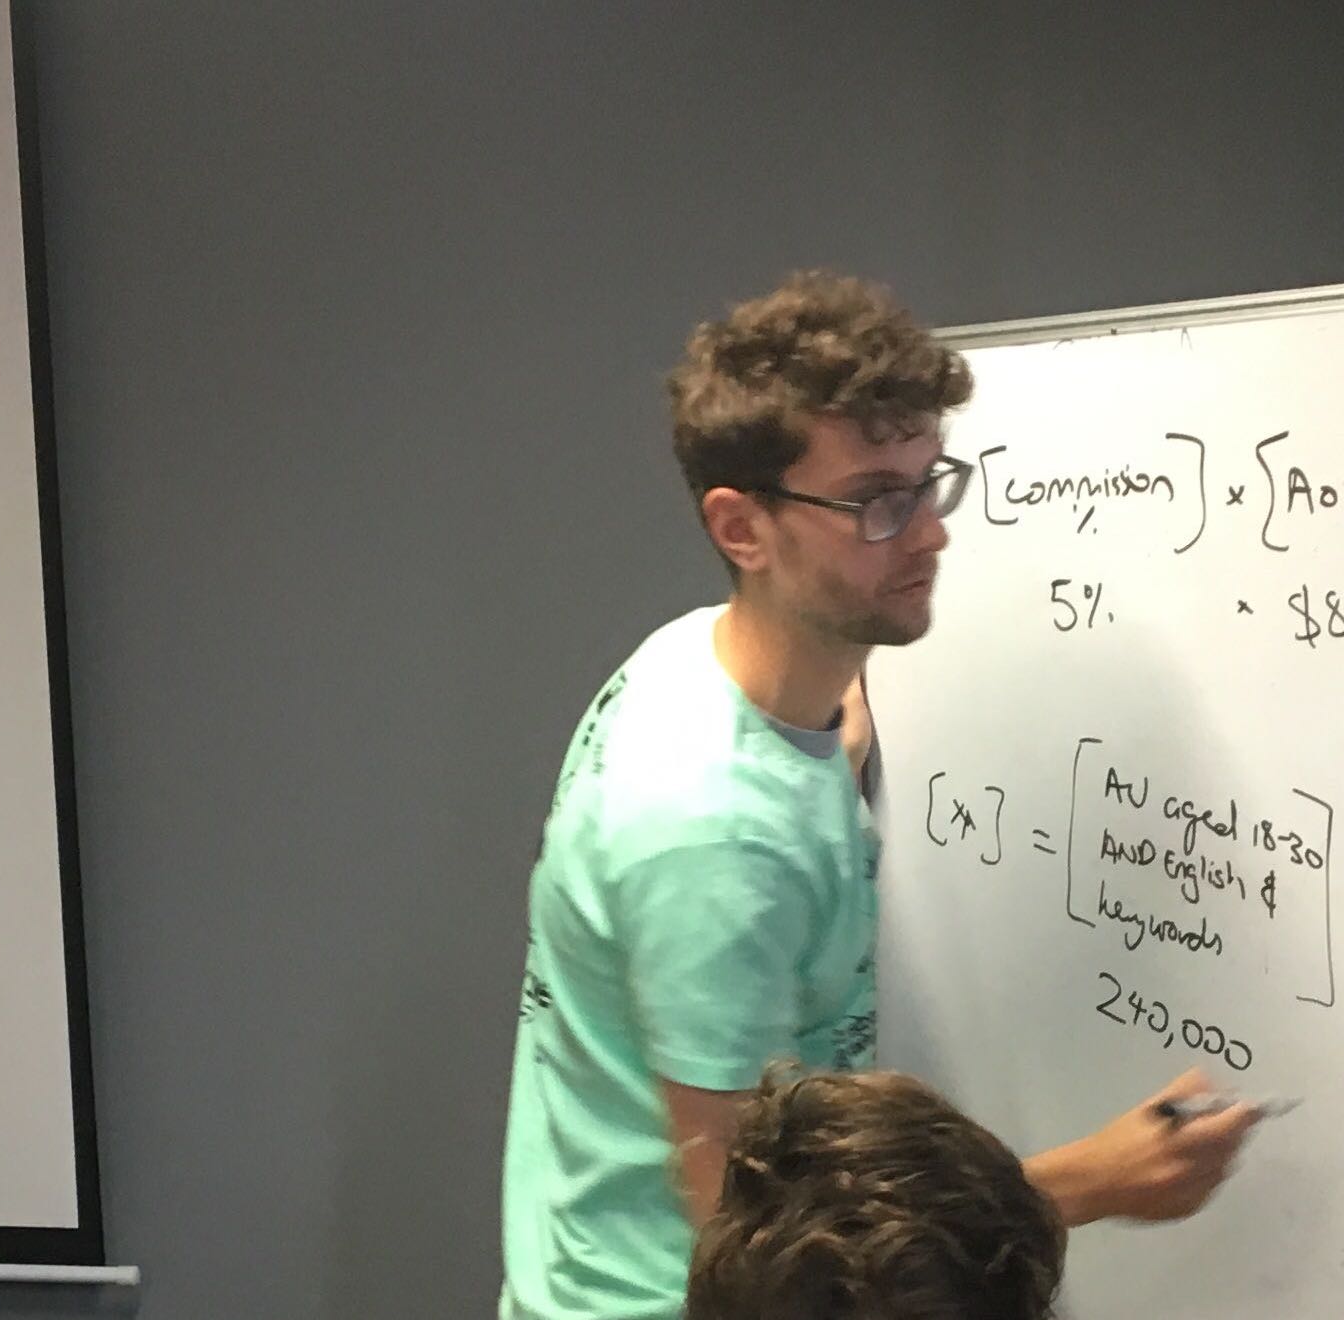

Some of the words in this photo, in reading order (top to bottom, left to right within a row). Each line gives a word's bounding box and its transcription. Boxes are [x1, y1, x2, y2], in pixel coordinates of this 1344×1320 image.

[1051, 578, 1115, 632] 5%
[1101, 827, 1156, 867] AND
[1163, 798, 1238, 856] aged
[1253, 821, 1325, 871] 18-30
[1095, 971, 1254, 1072] 240,000
